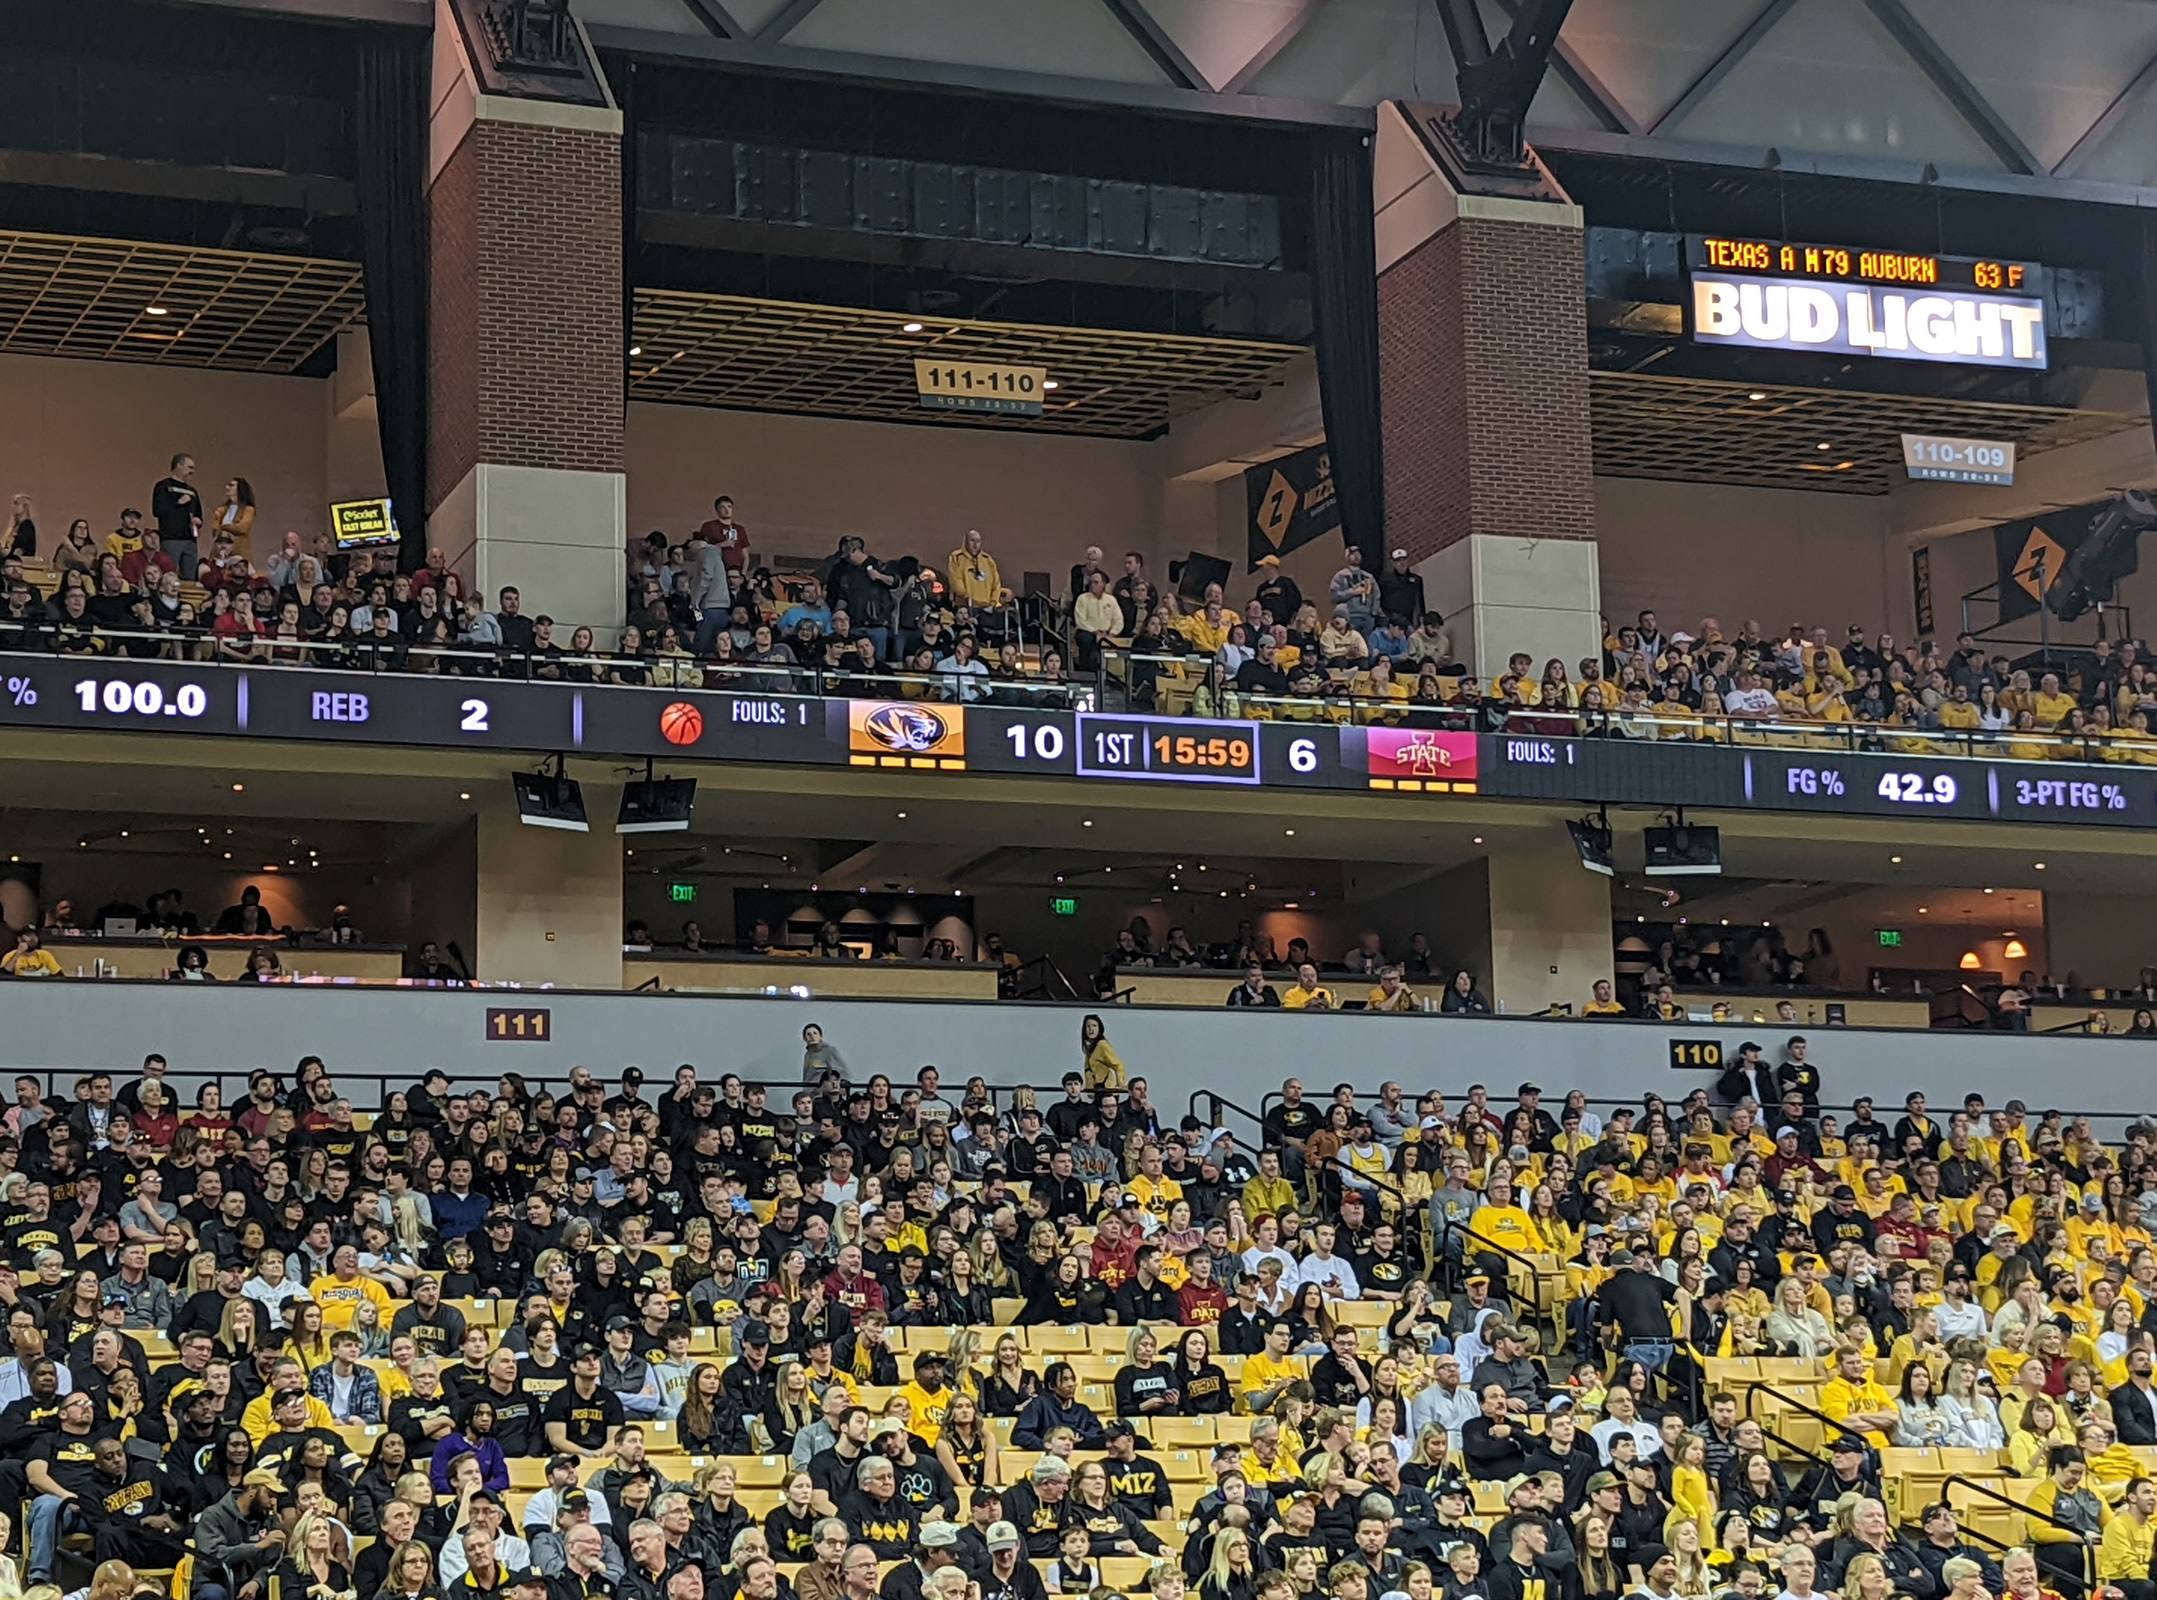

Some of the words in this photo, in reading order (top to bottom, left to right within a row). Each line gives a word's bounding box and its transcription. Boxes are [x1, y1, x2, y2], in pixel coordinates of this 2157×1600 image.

[1704, 240, 1769, 269] TEXAS
[1780, 247, 1794, 271] A
[1859, 253, 1937, 283] AUBURN
[1974, 262, 2001, 289] 63
[2008, 265, 2025, 287] F
[1694, 281, 1839, 343] BUD
[1847, 291, 2041, 359] LIGHT
[928, 367, 1034, 393] 111-110
[1913, 442, 2005, 467] 110-109
[75, 680, 207, 717] 100.0
[312, 691, 369, 722] REB
[732, 699, 786, 725] FOULS:
[799, 703, 807, 726] 1
[460, 700, 488, 731] 2
[1007, 724, 1064, 760] 10
[1095, 732, 1134, 766] 1ST
[1154, 735, 1250, 768] 15:59
[1288, 738, 1317, 772] 6
[1396, 743, 1451, 768] STATE
[1507, 740, 1556, 764] FOULS:
[1567, 743, 1575, 765] 1
[1878, 772, 1957, 804] 42.9
[672, 884, 695, 902] EXIT
[1055, 898, 1075, 914] EXIT
[493, 1013, 545, 1036] 111
[1673, 1044, 1719, 1065] 110
[1110, 1472, 1156, 1496] MIZ
